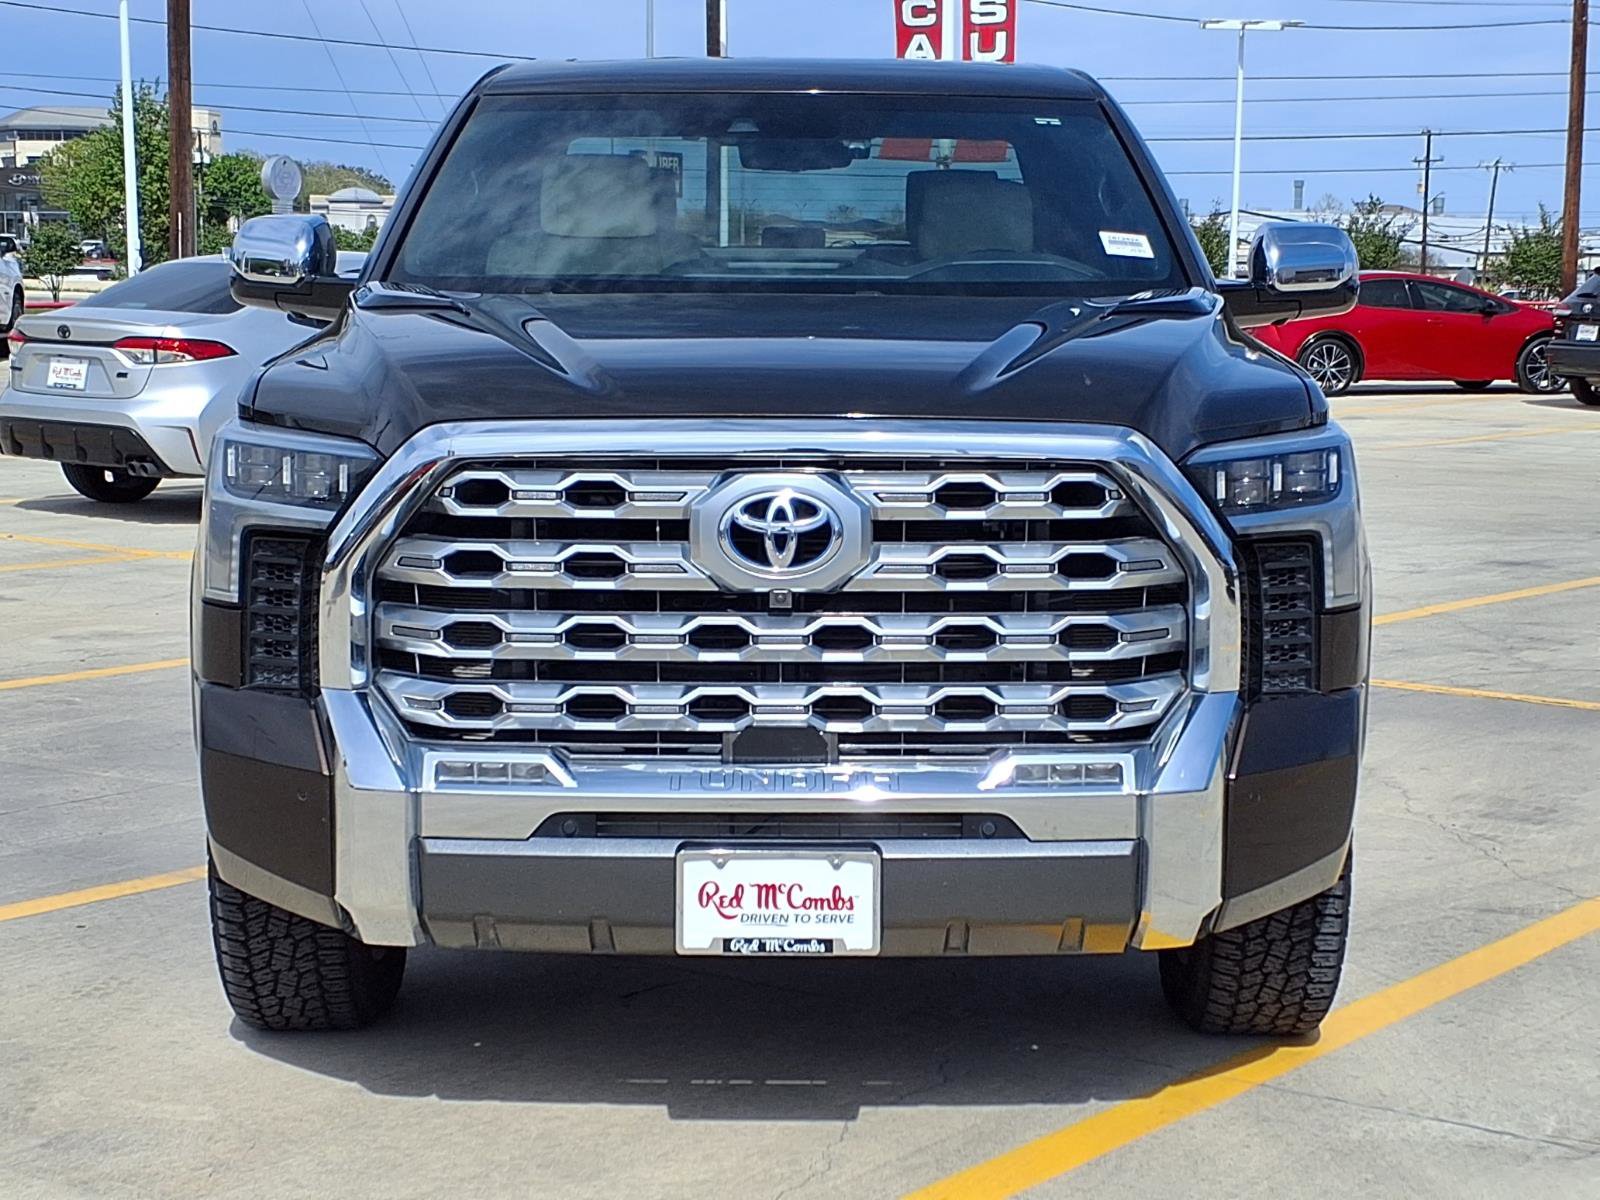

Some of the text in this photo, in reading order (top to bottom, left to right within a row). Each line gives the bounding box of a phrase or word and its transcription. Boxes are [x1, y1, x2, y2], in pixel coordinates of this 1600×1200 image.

[664, 769, 900, 792] TUNDRA
[698, 881, 855, 919] Red McCombs
[740, 913, 854, 924] DRIVEN TO SERVE
[730, 938, 826, 954] Red McCombs
